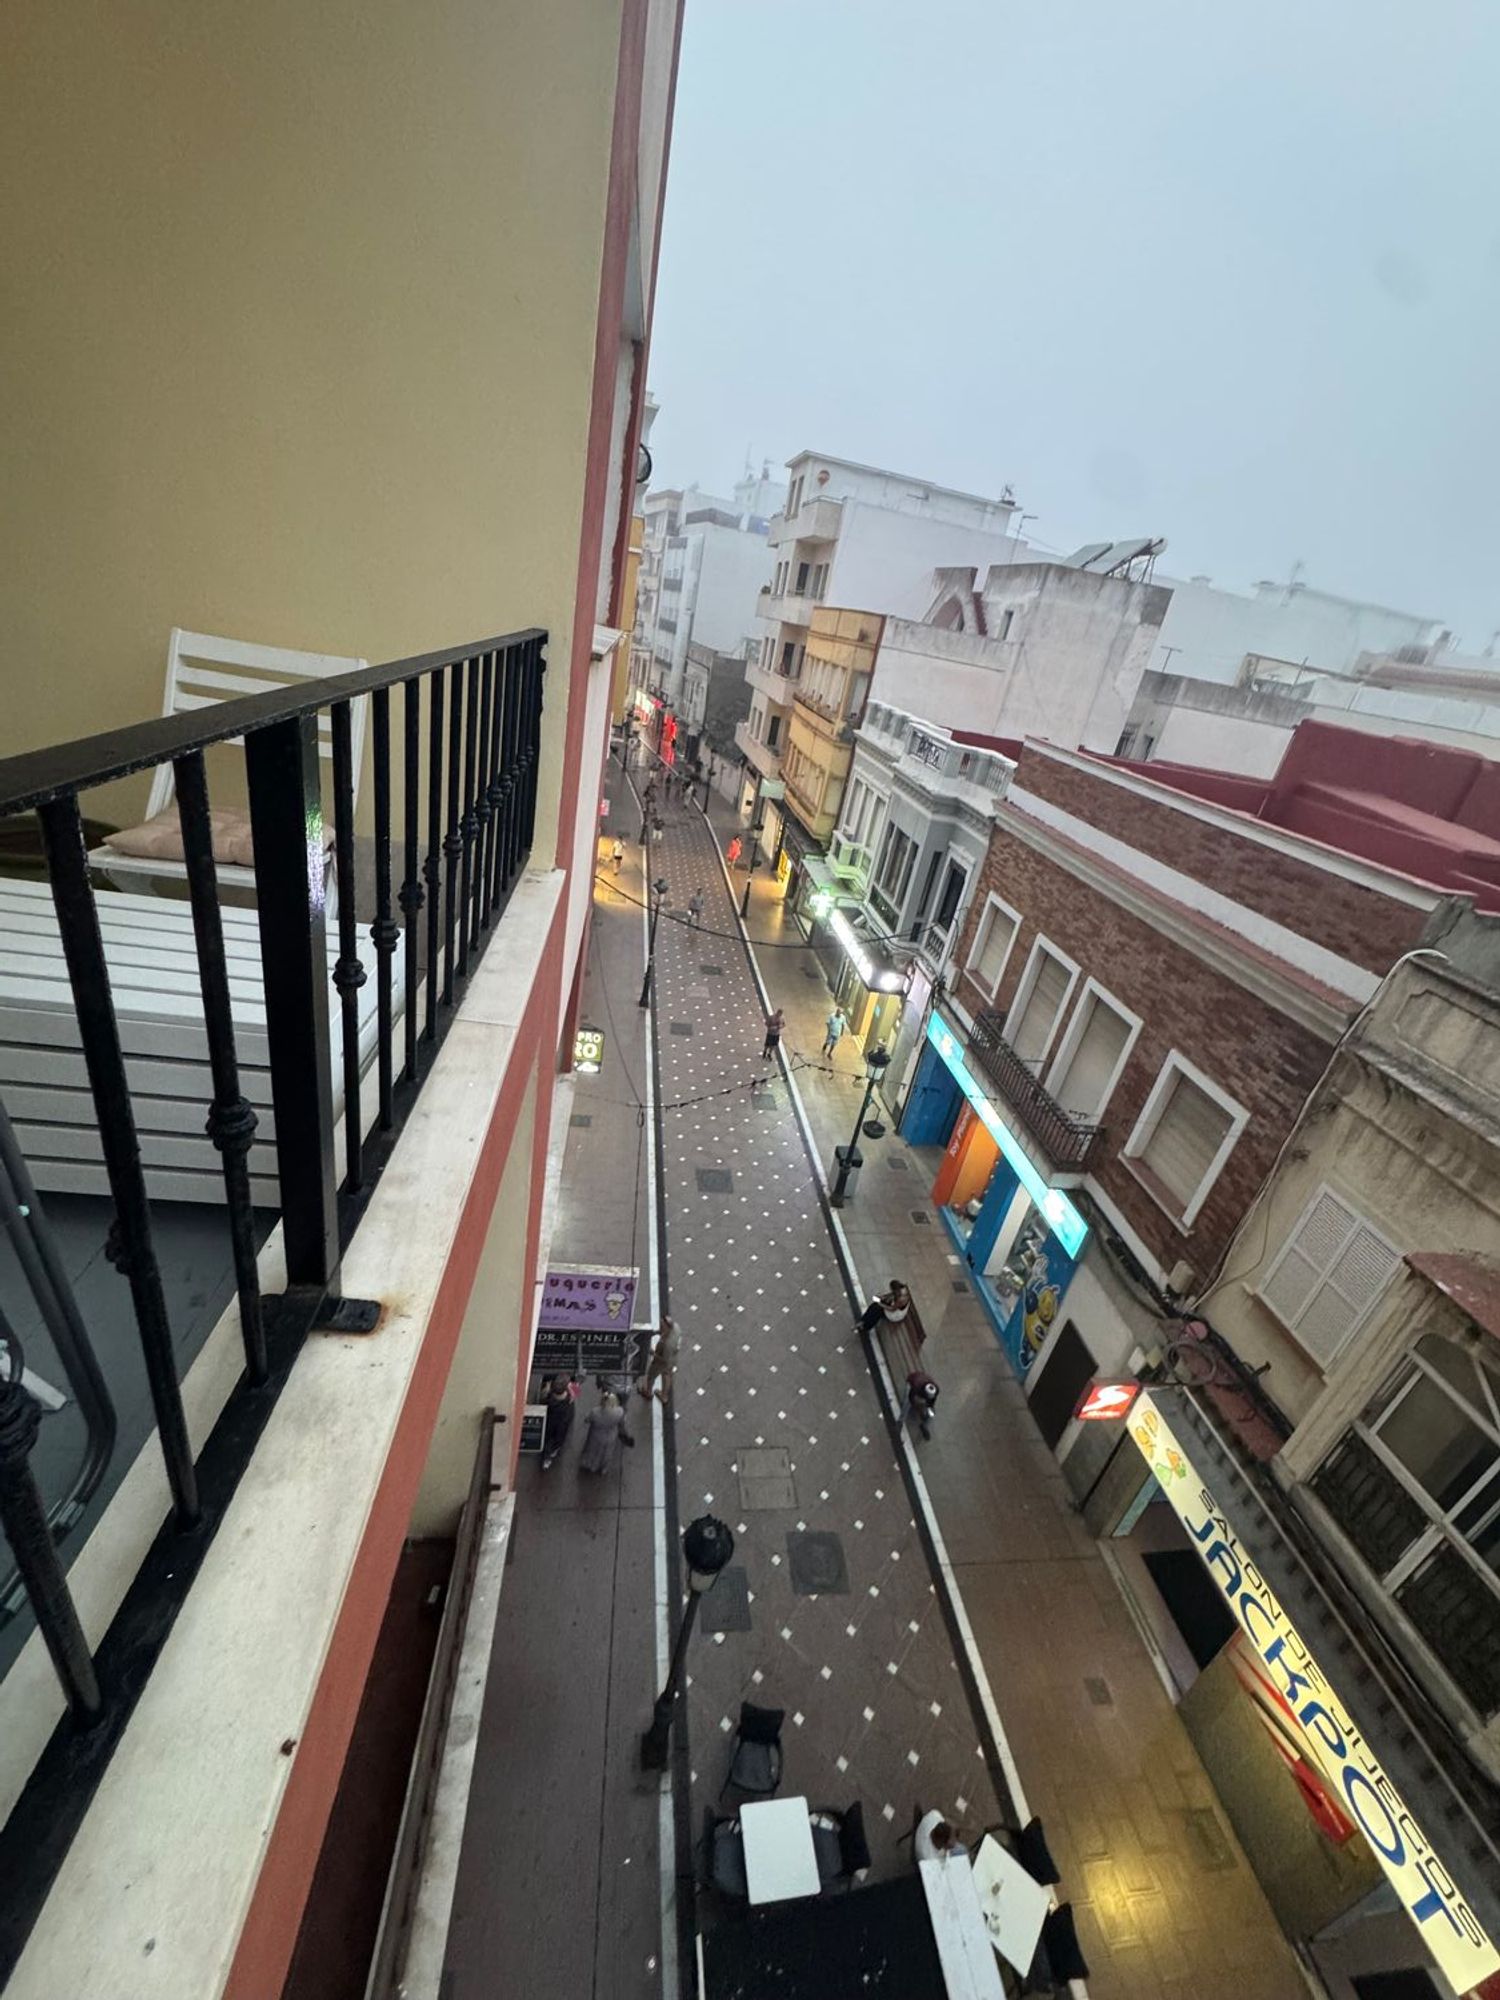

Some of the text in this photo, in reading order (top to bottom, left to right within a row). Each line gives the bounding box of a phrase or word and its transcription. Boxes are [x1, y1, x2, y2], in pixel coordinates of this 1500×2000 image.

[1184, 1515, 1466, 1938] JACKPOT
[1199, 1488, 1487, 1948] SALON DE JUEGOS
